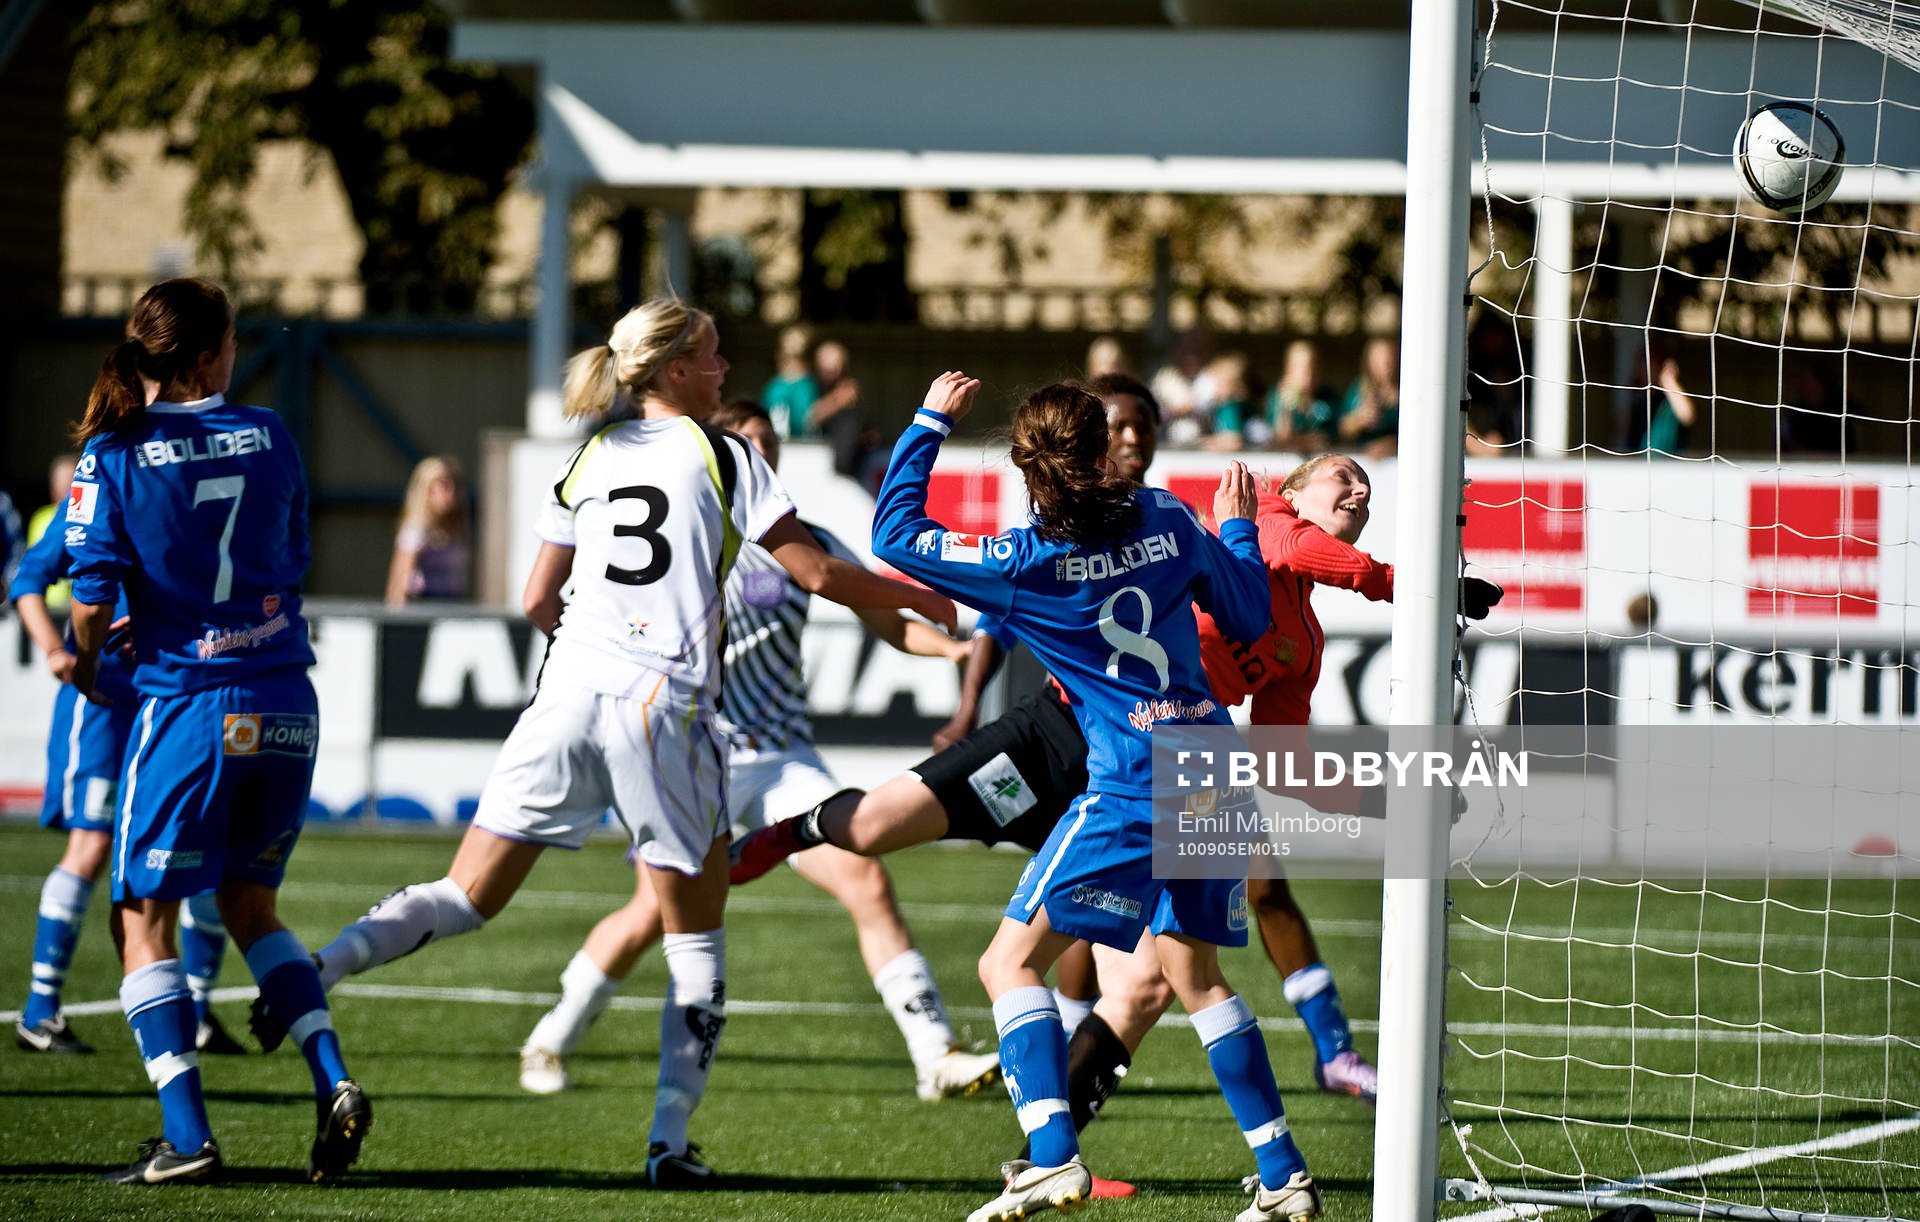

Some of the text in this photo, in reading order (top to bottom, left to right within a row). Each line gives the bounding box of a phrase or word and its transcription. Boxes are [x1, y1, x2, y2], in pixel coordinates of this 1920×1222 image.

[144, 426, 273, 467] BOLIDEN
[193, 474, 246, 605] 7
[604, 485, 672, 586] 3
[1098, 585, 1170, 693] 8
[1019, 861, 1036, 886] 8
